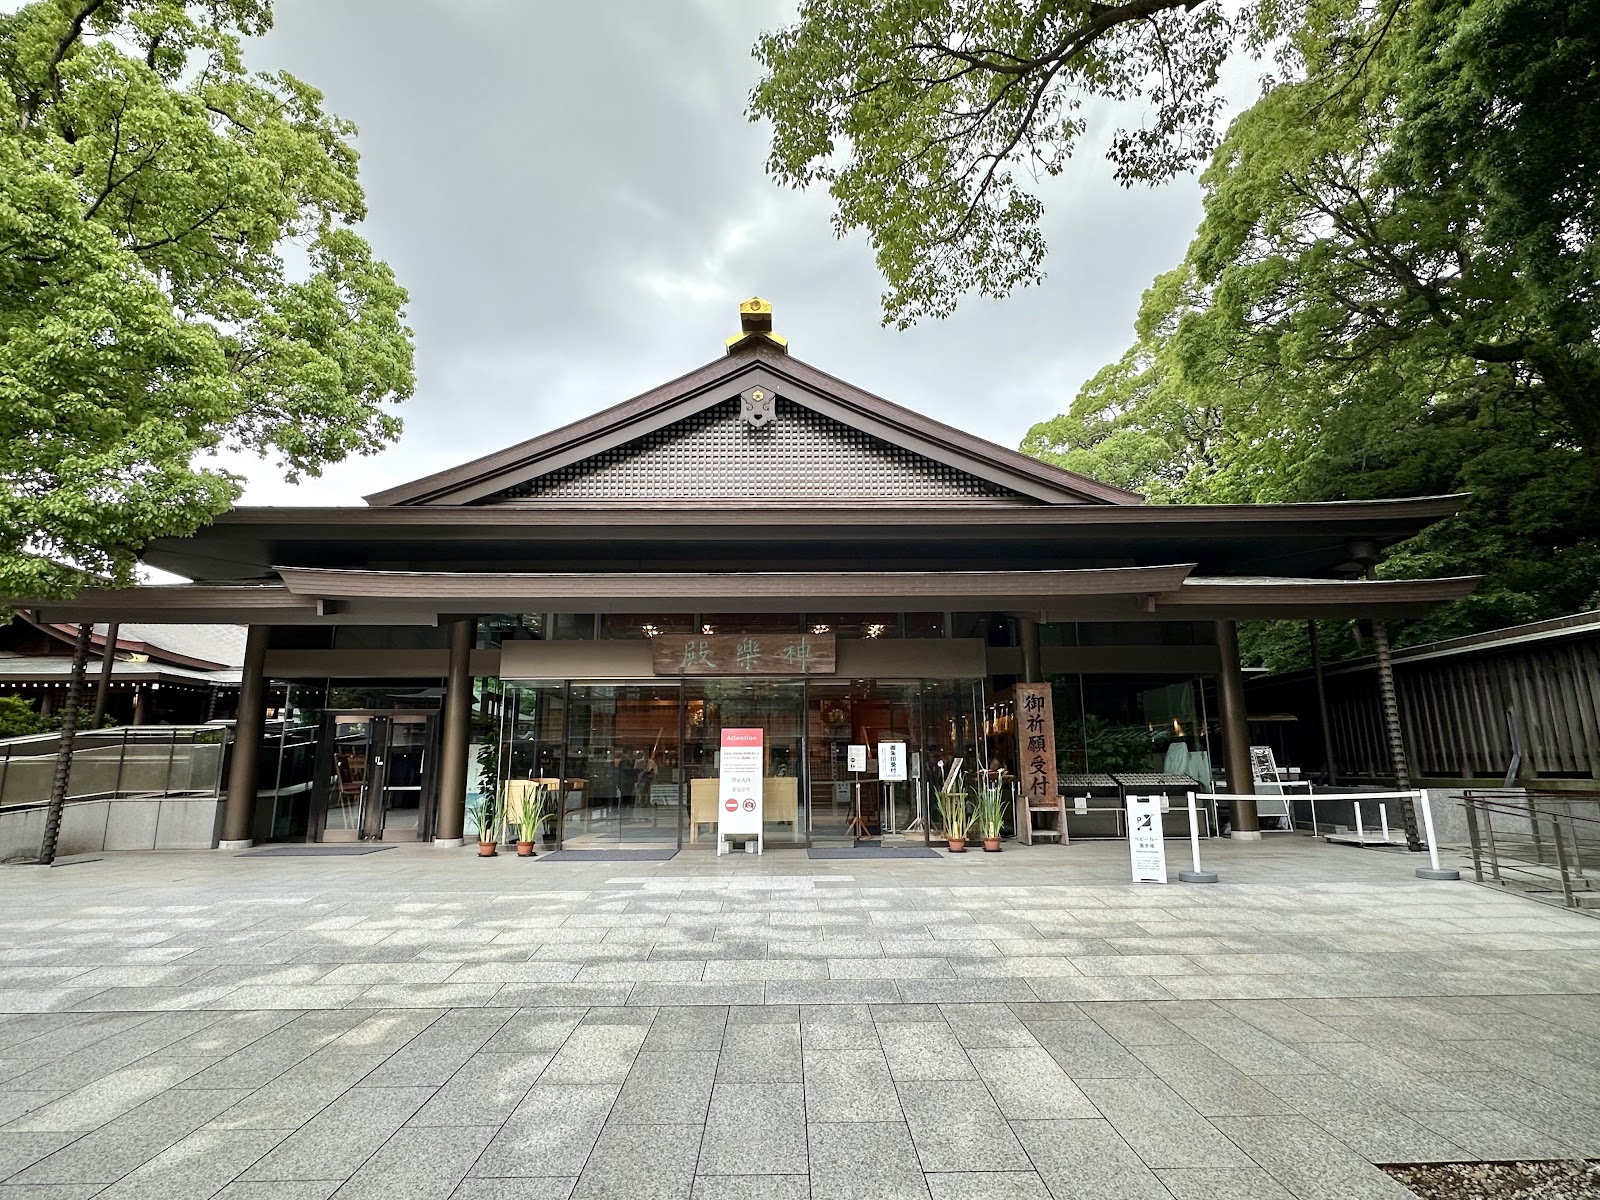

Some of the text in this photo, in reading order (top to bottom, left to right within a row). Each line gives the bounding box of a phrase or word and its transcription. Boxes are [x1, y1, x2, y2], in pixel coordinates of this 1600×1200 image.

[1024, 694, 1050, 796] 御祈願受付
